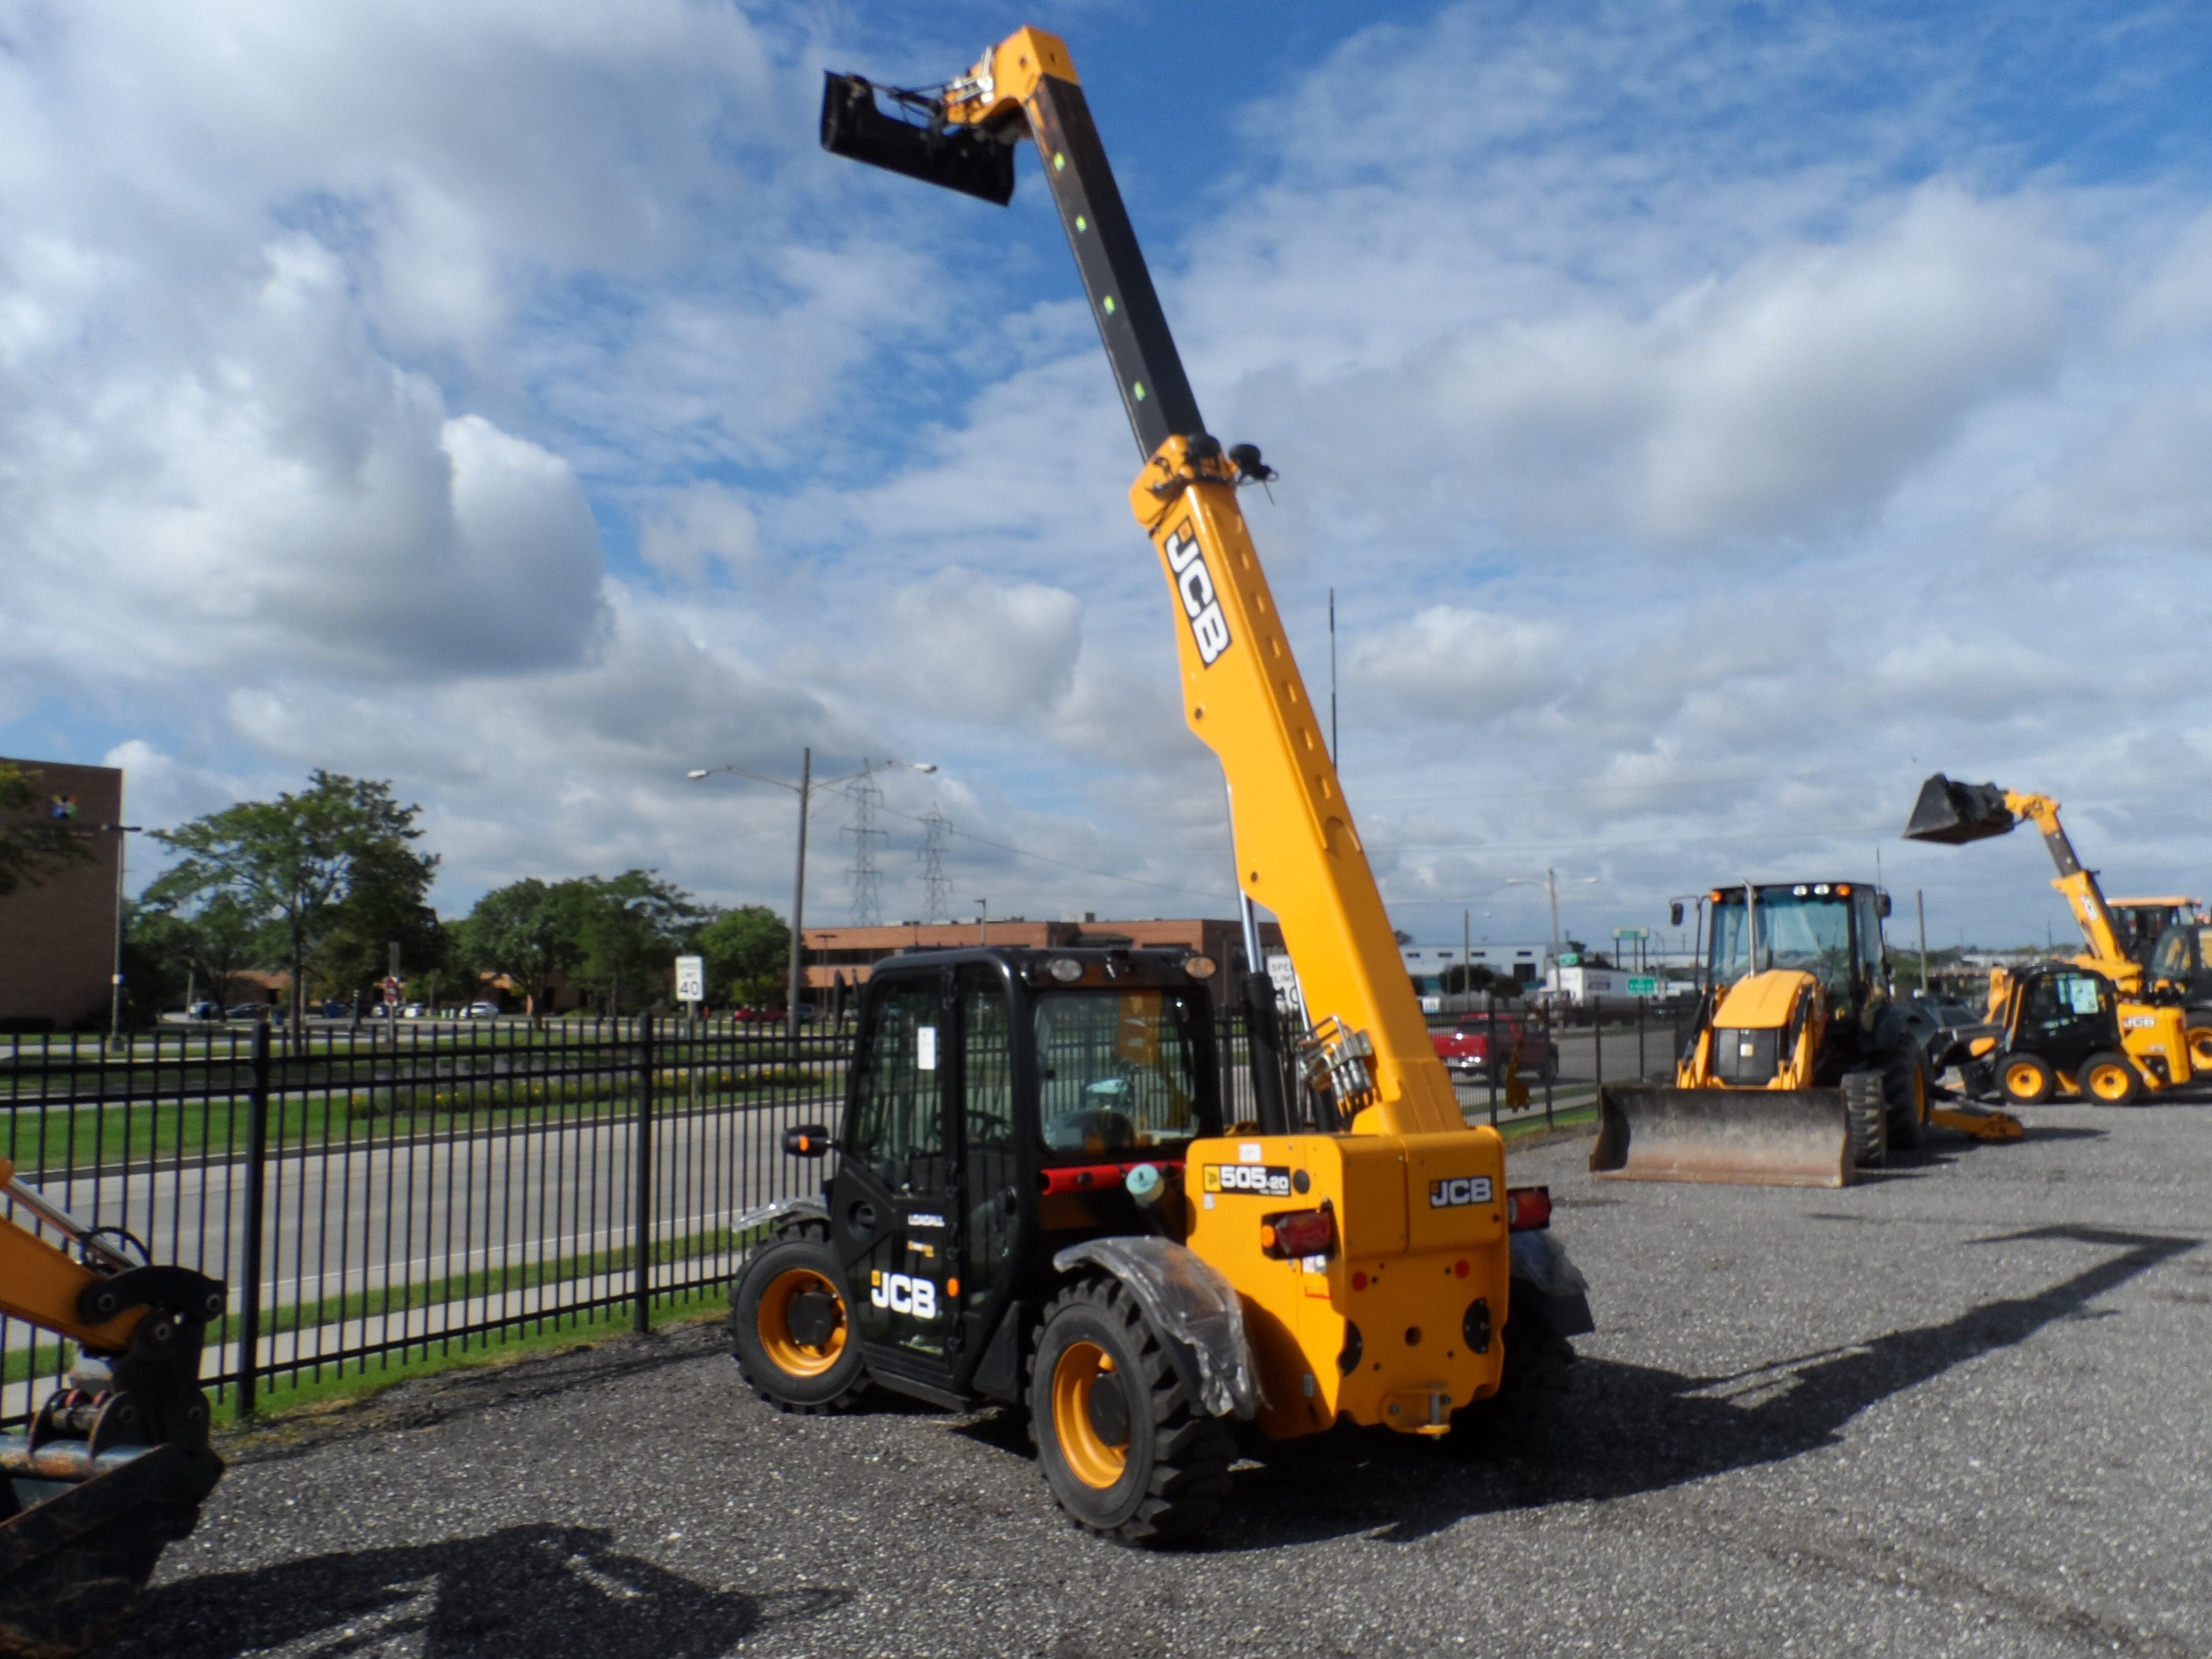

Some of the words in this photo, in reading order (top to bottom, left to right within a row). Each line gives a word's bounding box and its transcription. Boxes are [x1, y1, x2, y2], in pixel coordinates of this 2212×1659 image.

[1165, 533, 1229, 664] JCB
[2080, 895, 2098, 921] JCB
[1271, 963, 1291, 972] SPE
[680, 981, 701, 995] 40
[2123, 1017, 2155, 1028] JCB
[1221, 1165, 1289, 1190] 505-20
[1431, 1178, 1492, 1206] JCB
[908, 1214, 946, 1227] LOADALL
[871, 1271, 936, 1319] JCB
